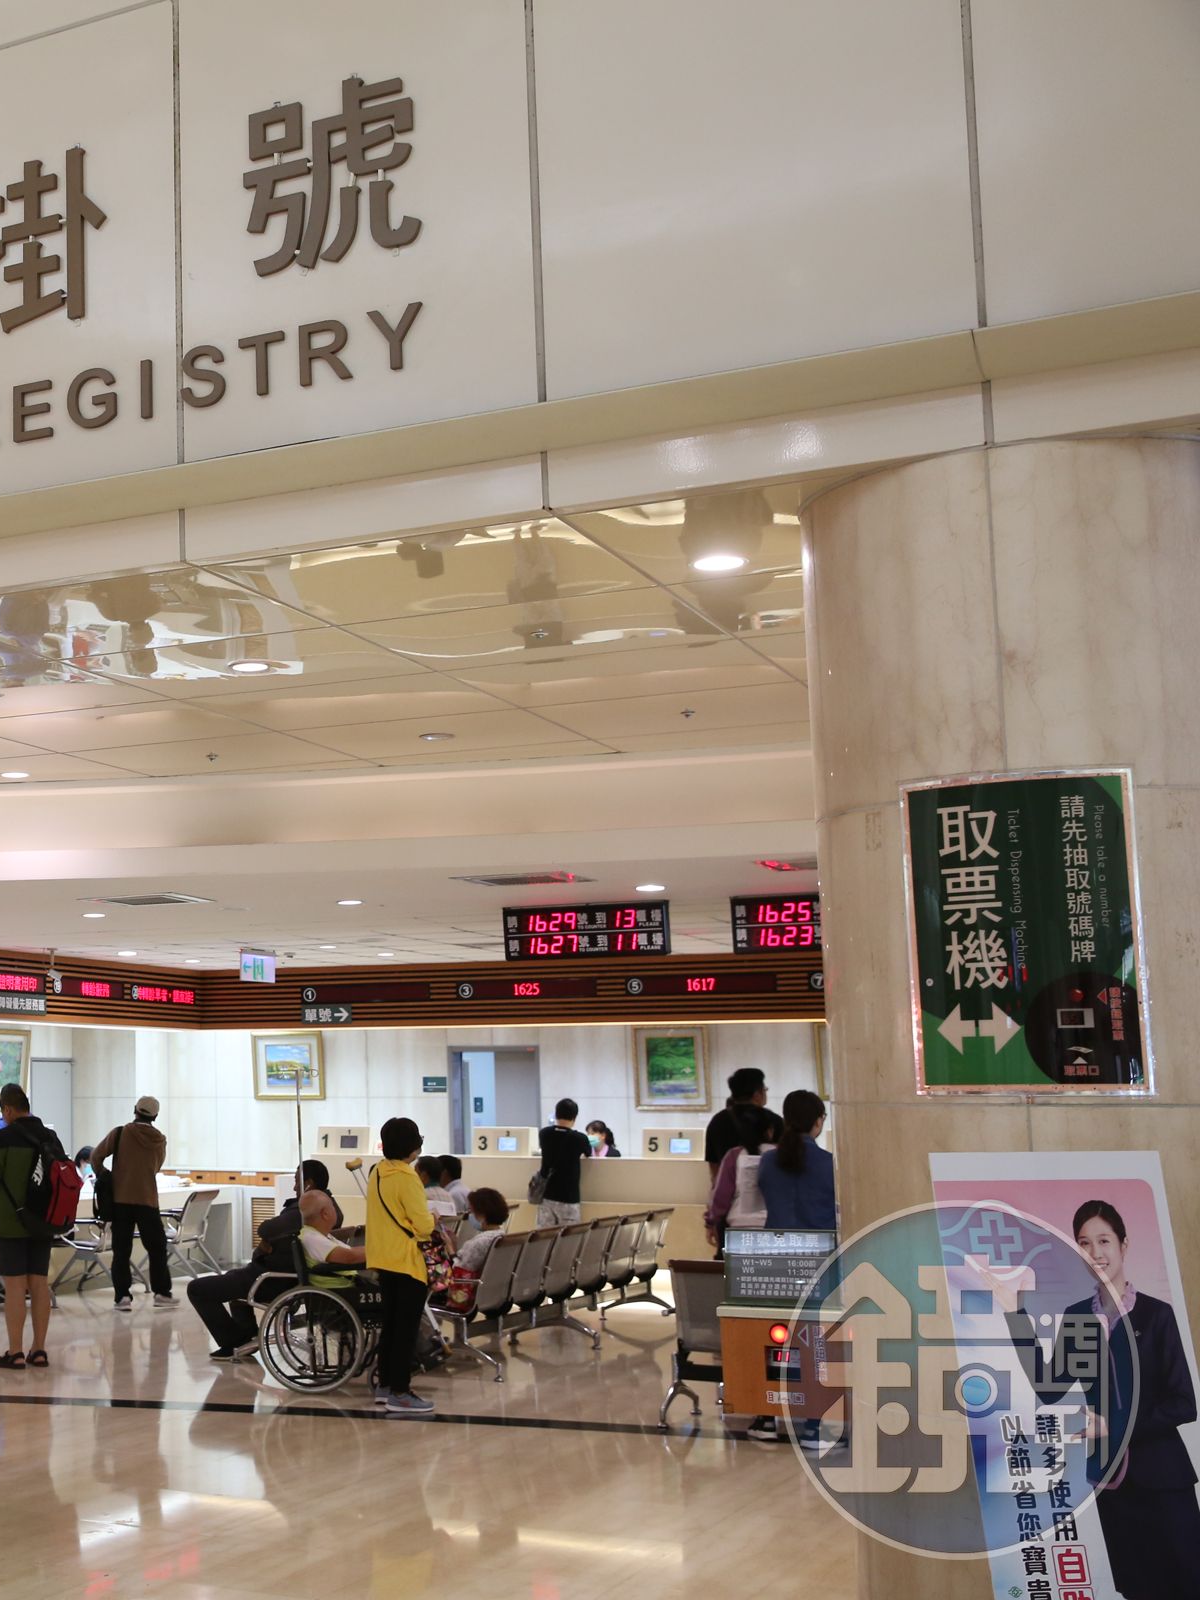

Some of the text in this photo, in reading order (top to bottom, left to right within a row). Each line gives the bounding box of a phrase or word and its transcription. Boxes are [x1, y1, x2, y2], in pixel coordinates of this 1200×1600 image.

[1094, 805, 1104, 839] Please
[1097, 846, 1108, 868] take
[1007, 808, 1029, 970] Ticket Dispensing Machine
[1059, 795, 1097, 963] 請先抽取號碼牌
[936, 804, 1009, 991] 取票機
[1099, 887, 1112, 928] number
[528, 912, 576, 932] 1629
[615, 909, 636, 927] 13
[758, 902, 811, 923] 1625
[530, 935, 578, 954] 1627
[617, 933, 637, 951] 11
[760, 925, 813, 946] 1623
[513, 983, 540, 996] 1625
[687, 978, 715, 991] 1617
[304, 1008, 332, 1022] 單號
[322, 1134, 328, 1148] 1
[478, 1136, 488, 1150] 3
[648, 1137, 658, 1152] 5
[359, 1292, 382, 1303] 238
